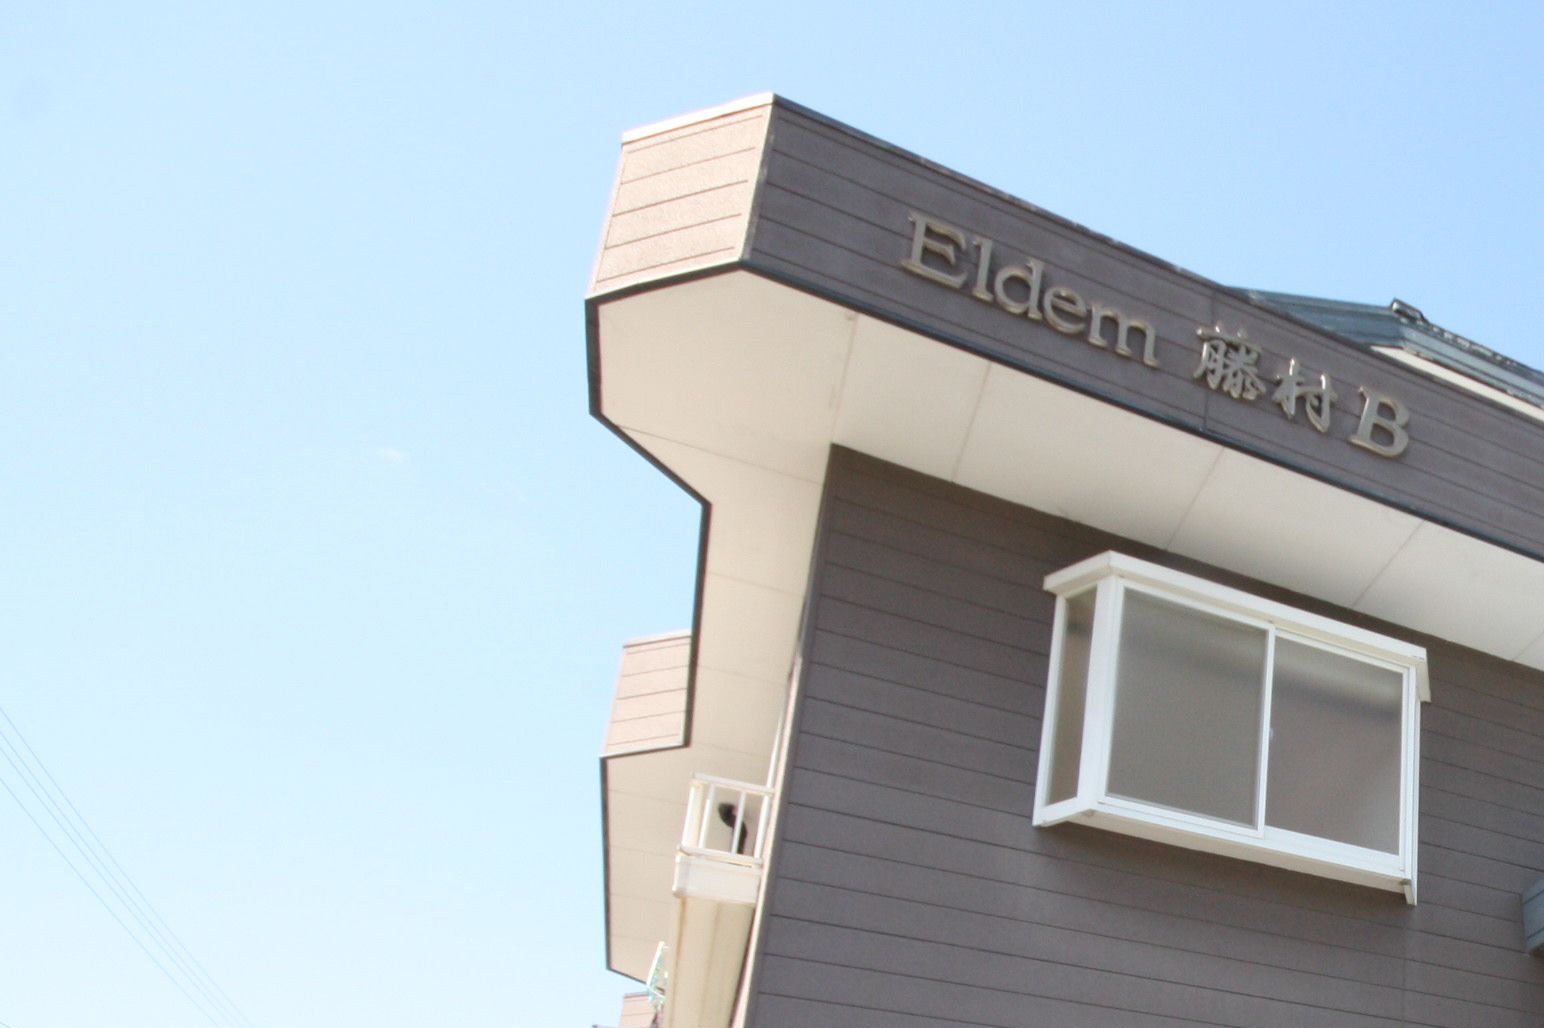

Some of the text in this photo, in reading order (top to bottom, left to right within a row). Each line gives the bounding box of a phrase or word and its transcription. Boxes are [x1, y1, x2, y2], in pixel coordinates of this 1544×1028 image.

[901, 213, 1410, 458] Eldem 藤村 B
